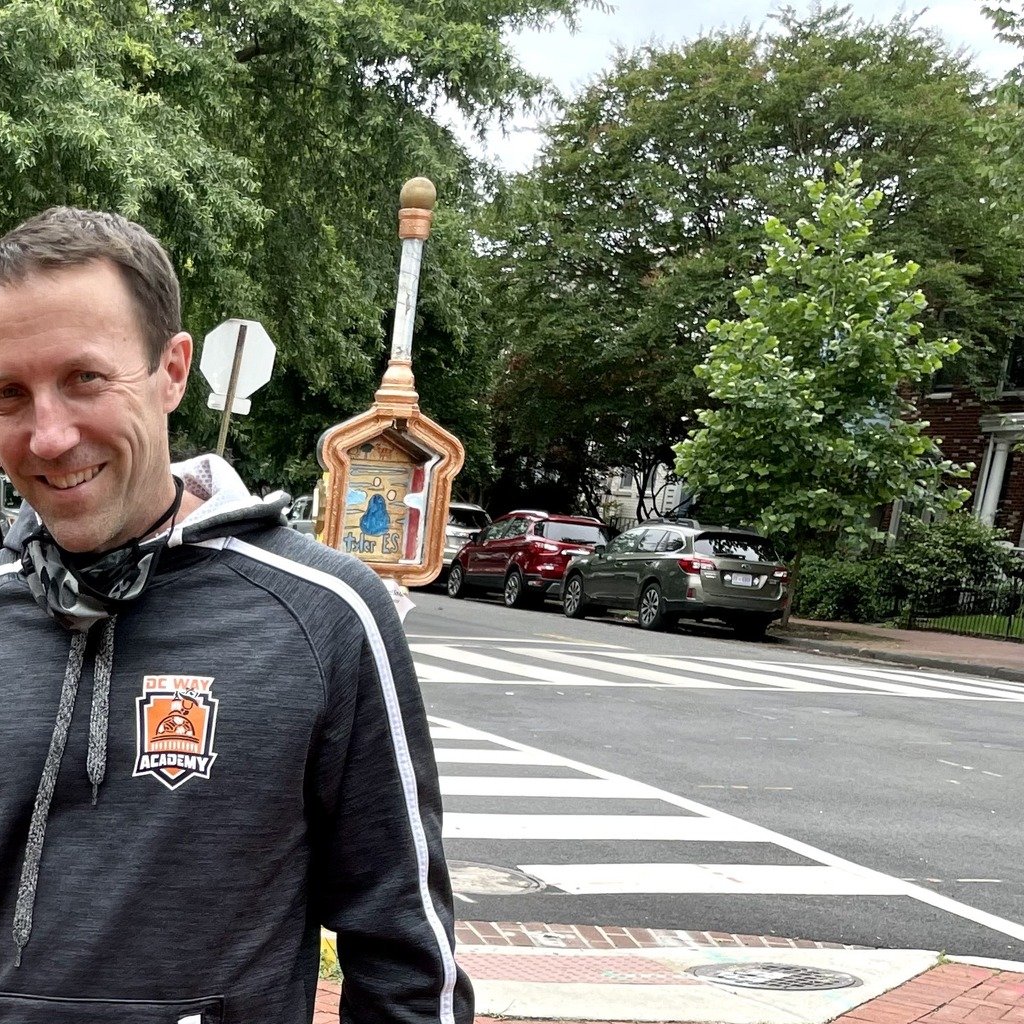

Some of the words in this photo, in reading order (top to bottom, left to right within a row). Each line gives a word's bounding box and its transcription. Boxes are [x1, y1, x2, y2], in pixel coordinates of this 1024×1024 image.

[382, 532, 400, 554] ES
[145, 678, 167, 690] DC
[173, 678, 210, 691] WAY
[139, 753, 209, 772] ACADEMY
